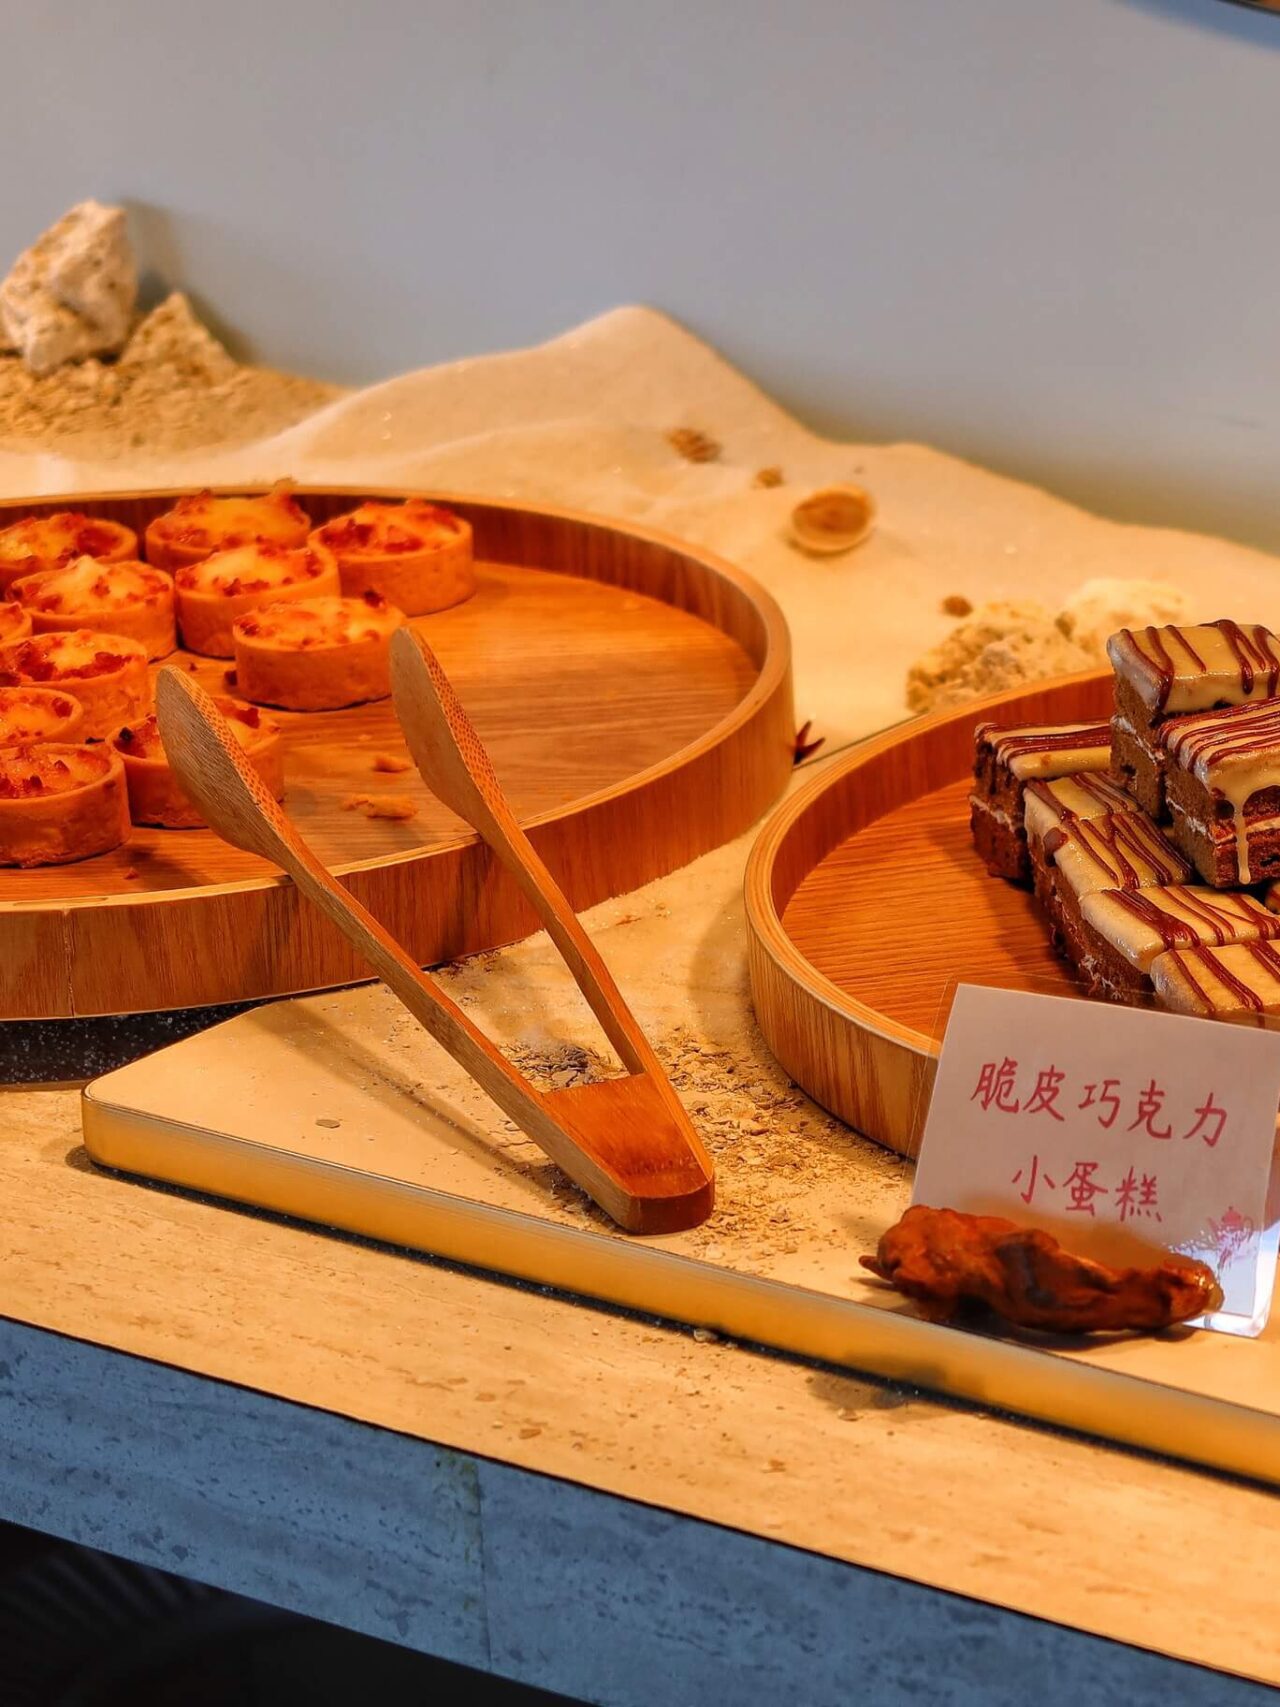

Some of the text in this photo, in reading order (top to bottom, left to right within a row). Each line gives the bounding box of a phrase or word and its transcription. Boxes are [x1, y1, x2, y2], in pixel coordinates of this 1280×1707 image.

[970, 1056, 1228, 1148] 脆皮巧克力
[1011, 1155, 1163, 1223] 小蛋糕
